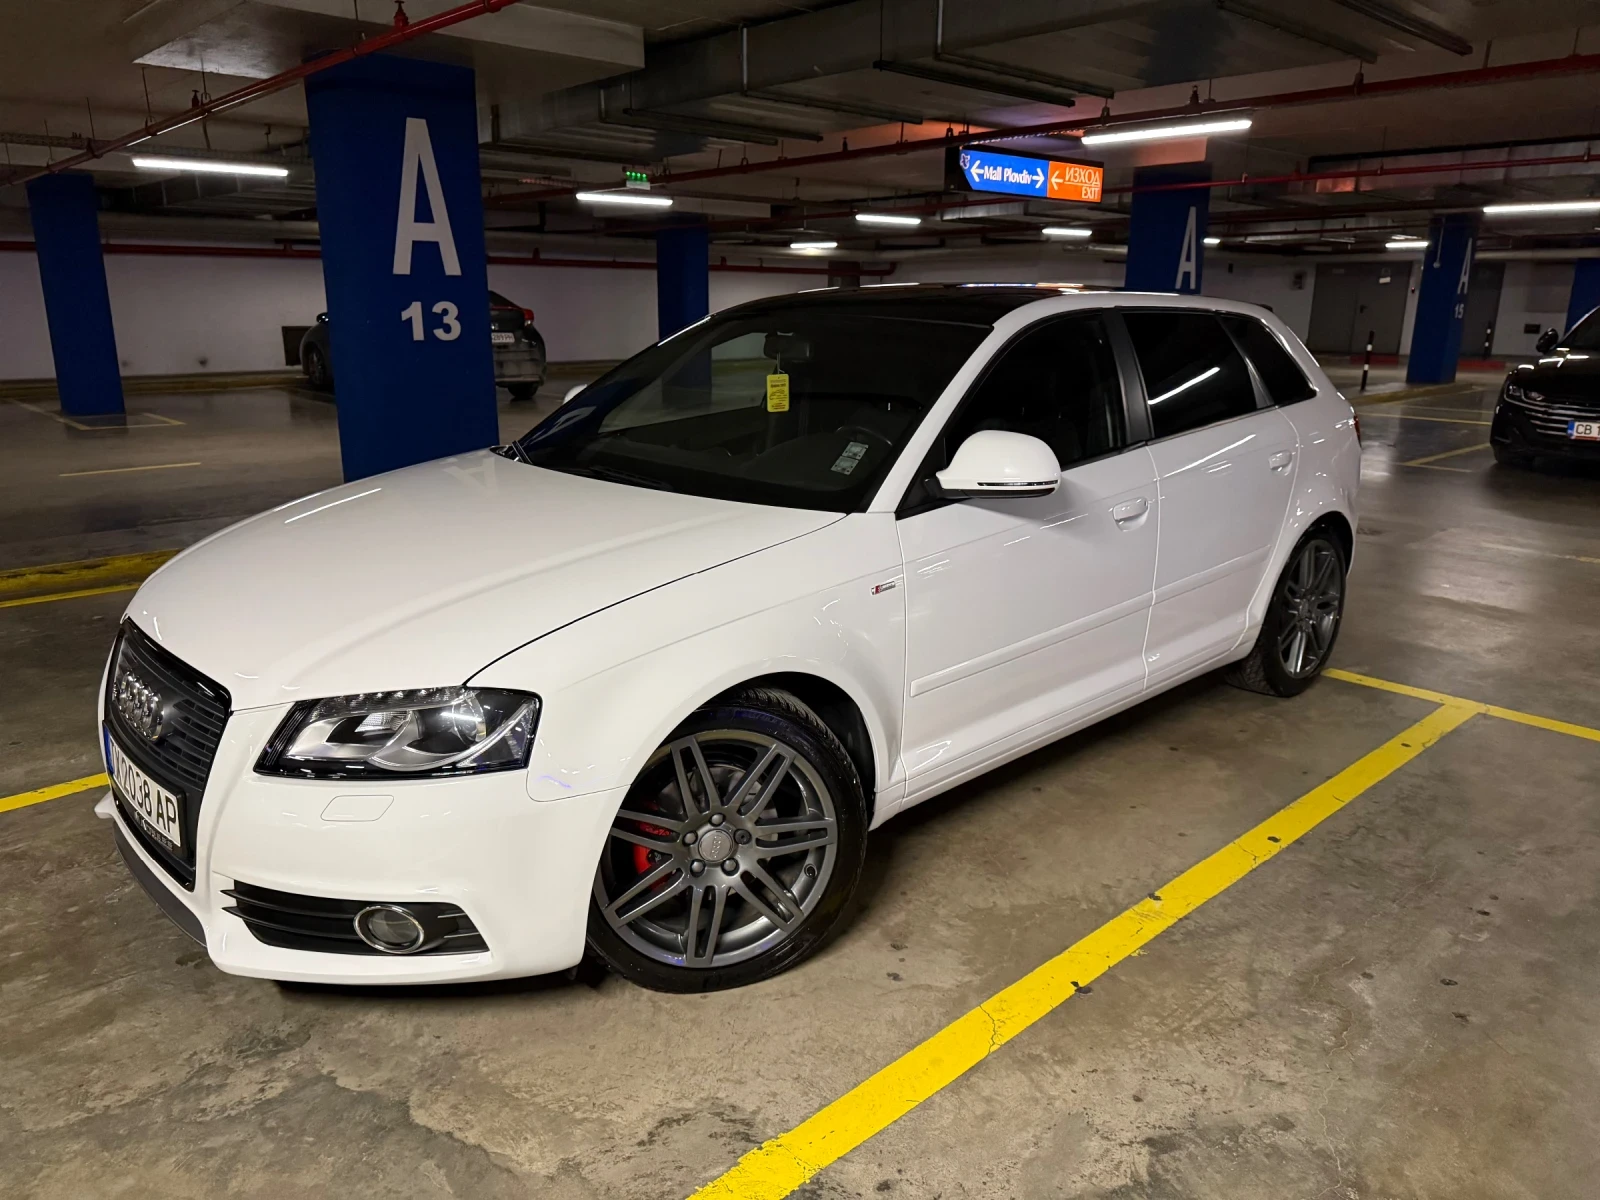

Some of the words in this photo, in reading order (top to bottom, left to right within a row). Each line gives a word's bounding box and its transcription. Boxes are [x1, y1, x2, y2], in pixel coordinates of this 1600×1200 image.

[983, 165, 1003, 181] Mall
[1003, 167, 1033, 185] Plovdiv
[1065, 166, 1101, 187] ИЗХОД
[393, 117, 462, 276] A
[1081, 186, 1100, 200] EXIT
[1175, 205, 1197, 289] A
[1457, 237, 1473, 294] A
[401, 301, 462, 341] 13
[1454, 303, 1465, 319] 15
